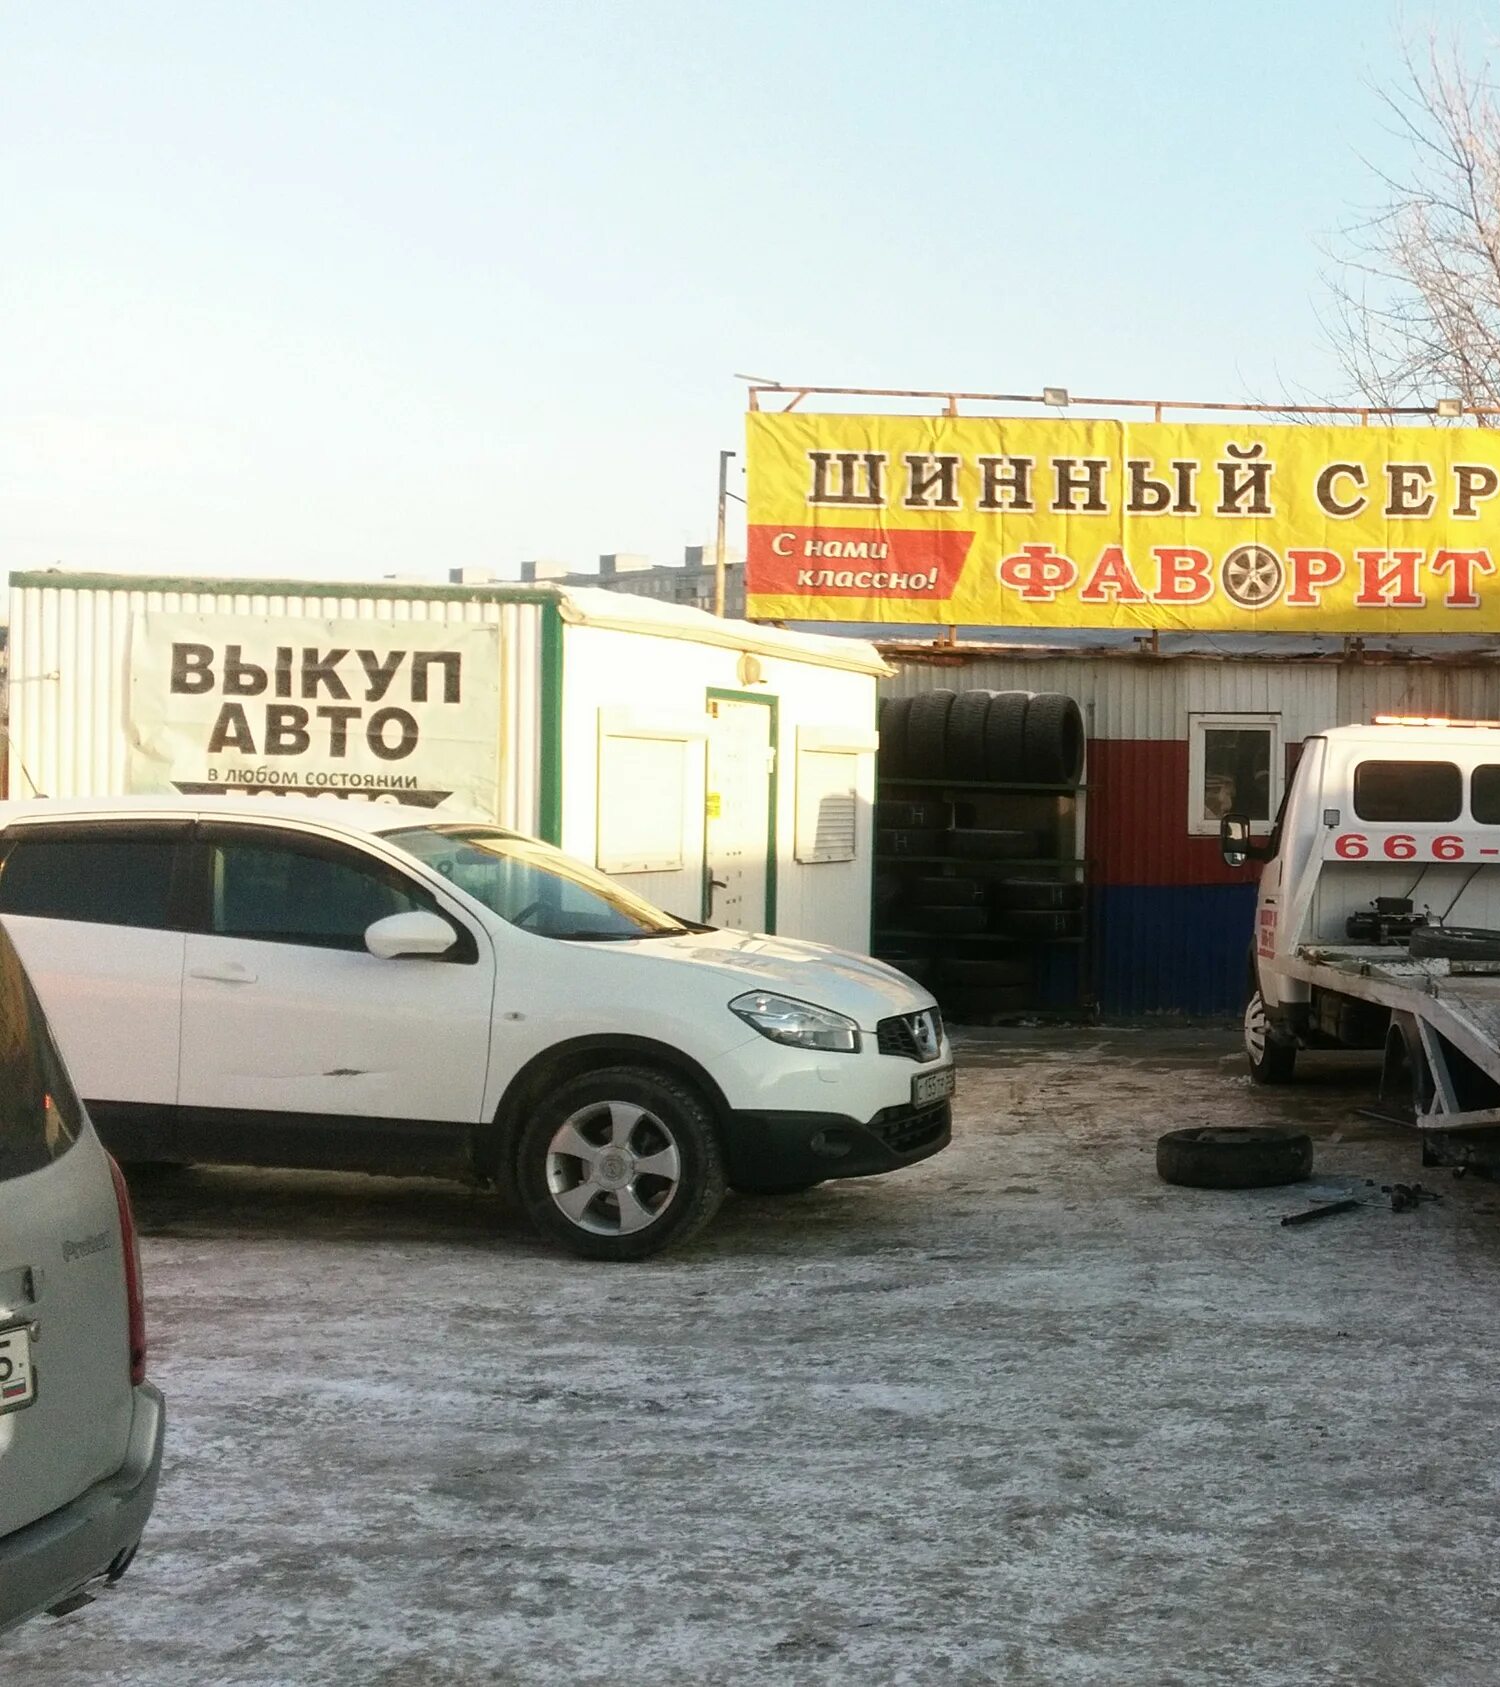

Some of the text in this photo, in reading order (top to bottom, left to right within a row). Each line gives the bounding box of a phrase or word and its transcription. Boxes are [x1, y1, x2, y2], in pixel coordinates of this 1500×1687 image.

[808, 443, 1272, 515] ШИННЫЙ
[771, 533, 888, 560] С нами
[797, 568, 938, 591] классно!
[170, 642, 461, 704] ВЫКУП
[207, 702, 419, 761] АВТО
[207, 765, 418, 789] в любом состоянии
